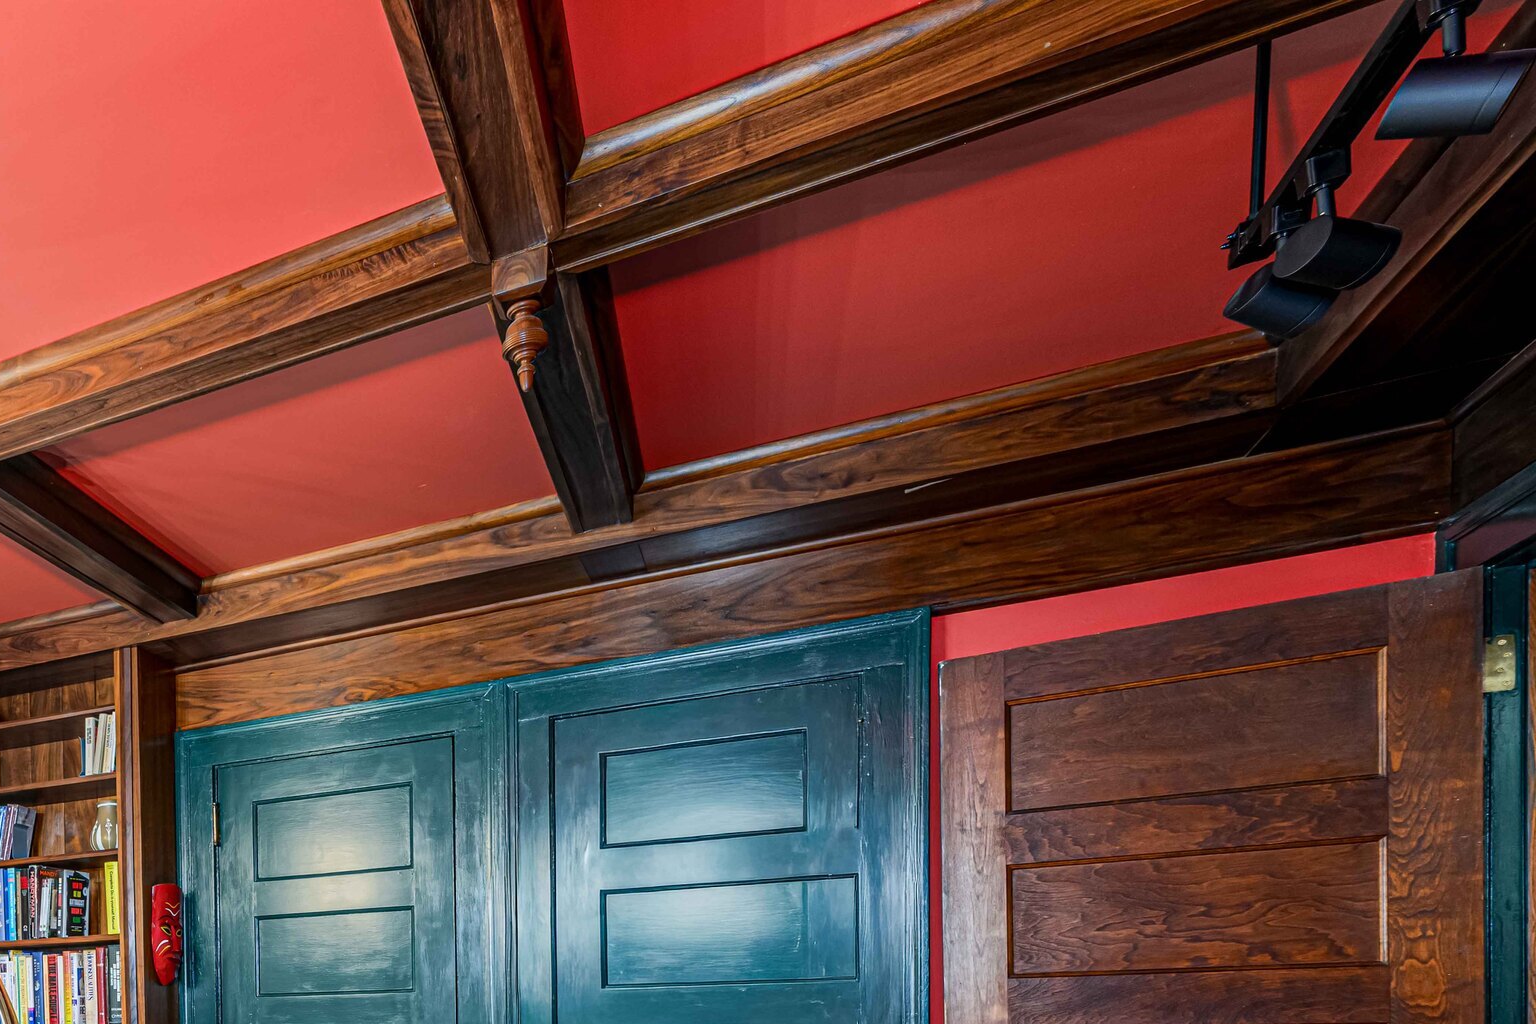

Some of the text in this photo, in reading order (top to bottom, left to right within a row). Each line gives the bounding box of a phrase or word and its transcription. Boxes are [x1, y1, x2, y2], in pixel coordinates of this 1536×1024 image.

[48, 963, 57, 1018] THE MALE COUPLE
